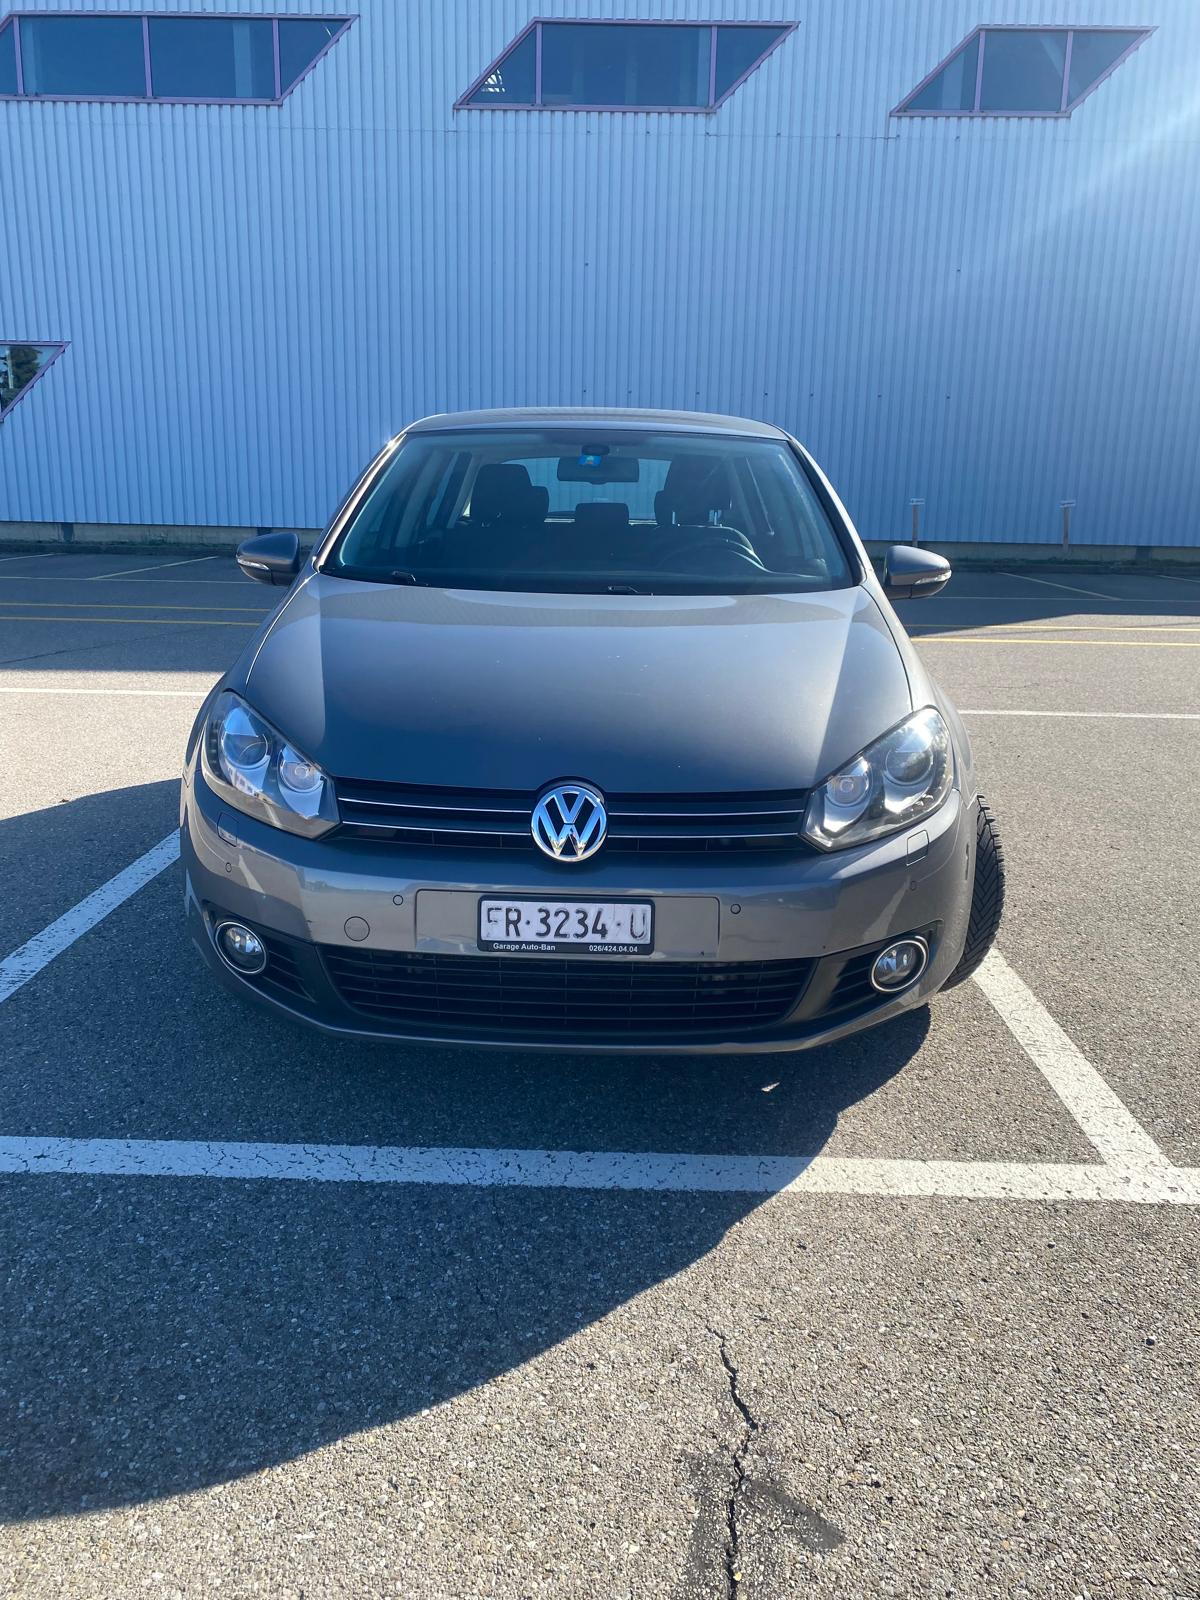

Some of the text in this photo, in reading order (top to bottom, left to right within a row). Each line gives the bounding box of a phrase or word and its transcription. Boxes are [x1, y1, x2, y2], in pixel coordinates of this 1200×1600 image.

[493, 942, 556, 951] Garage Auto-Ban
[589, 945, 638, 953] 026/424.04.04
